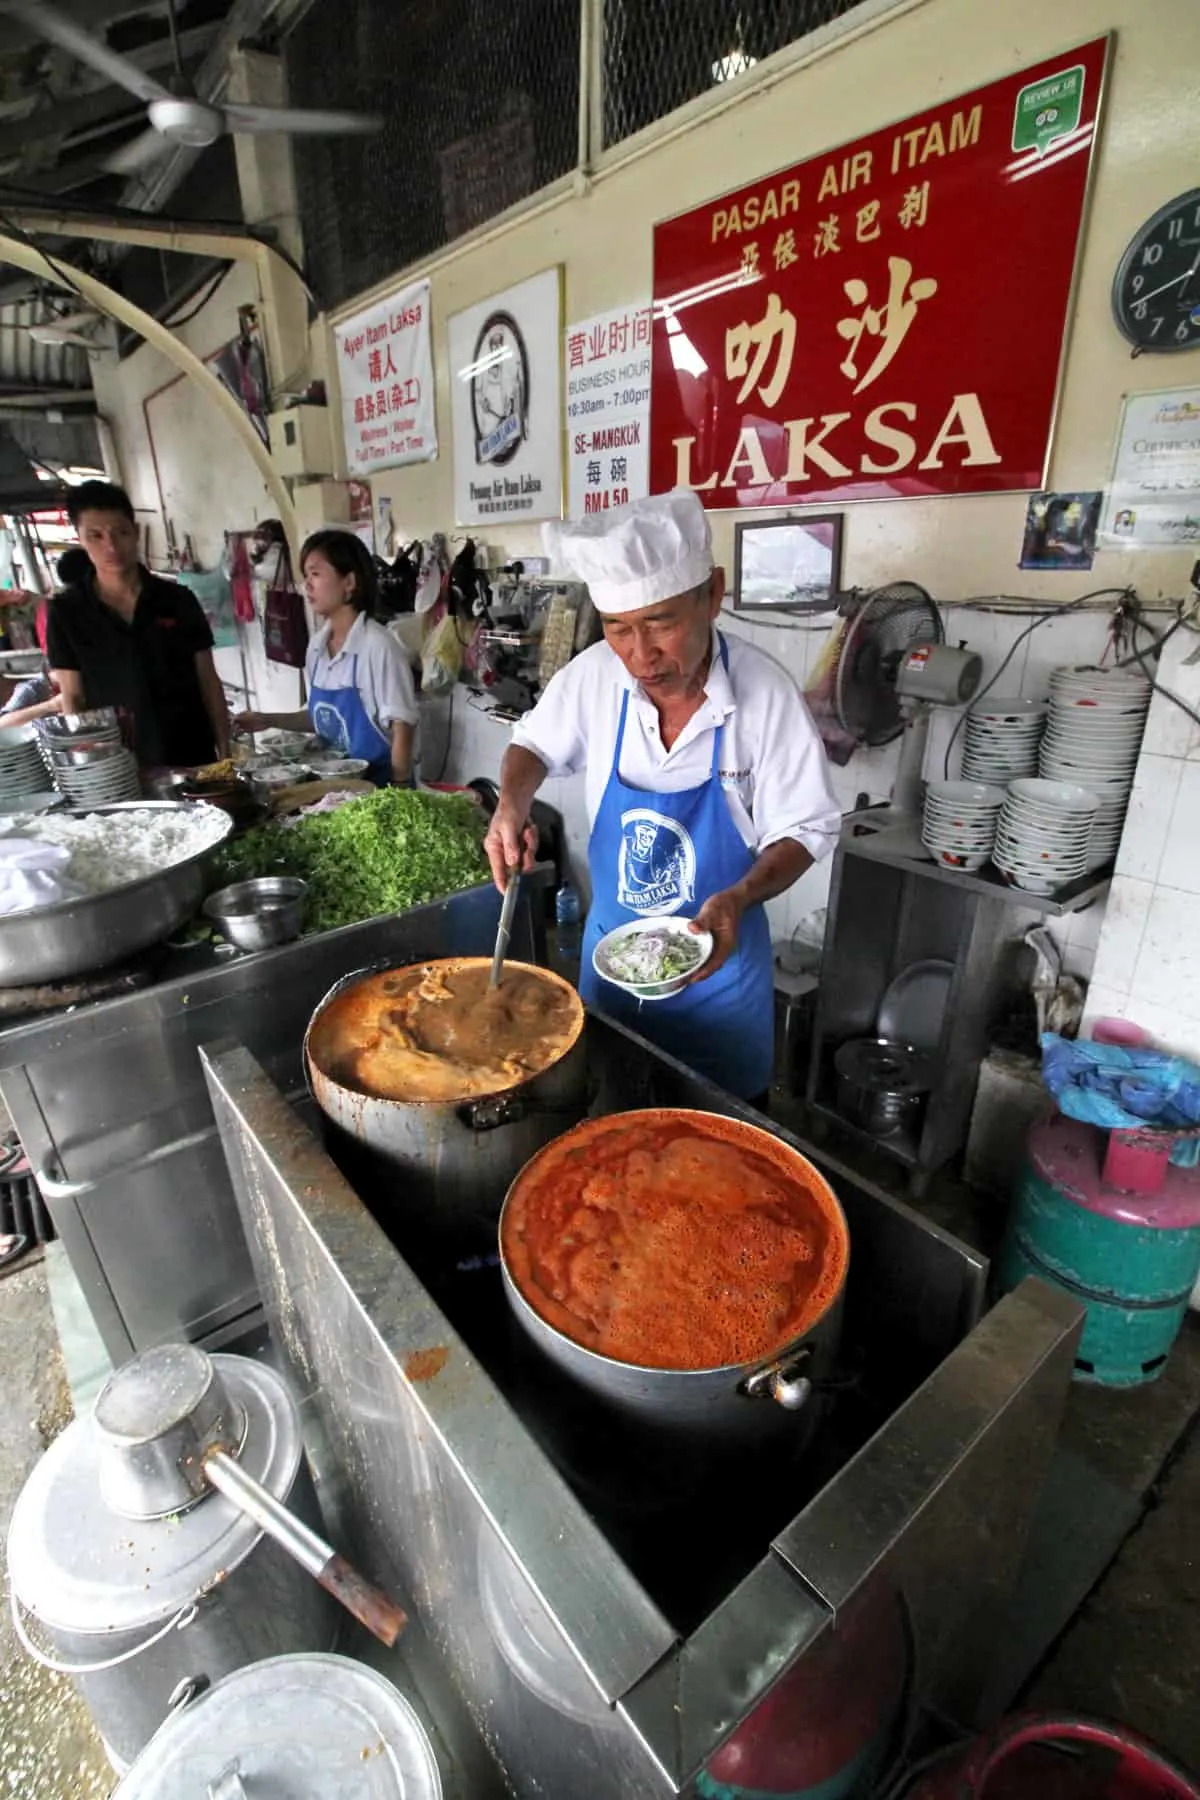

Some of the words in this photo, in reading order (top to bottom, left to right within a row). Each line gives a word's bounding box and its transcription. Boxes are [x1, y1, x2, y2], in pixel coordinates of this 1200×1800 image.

[1023, 82, 1061, 106] REVIEW
[711, 179, 801, 244] PASAR
[816, 150, 873, 204] AIR
[890, 103, 983, 175] ITAM
[1168, 216, 1184, 241] 11
[1142, 243, 1163, 267] 10
[1131, 274, 1145, 295] 9
[389, 304, 422, 336] Laksa
[1133, 300, 1148, 321] 8
[567, 307, 653, 370] 营业时间
[724, 256, 938, 409] 叻沙
[1149, 315, 1165, 338] 7
[1174, 318, 1190, 341] 6
[367, 343, 398, 384] 请人
[568, 367, 617, 396] BUSINESS
[567, 399, 605, 417] 10:30am
[574, 421, 641, 455] SE-MANGKUK
[671, 392, 1003, 492] LAKSA
[520, 473, 543, 494] Laksa
[585, 487, 629, 513] RM450
[650, 881, 679, 902] LAKSA
